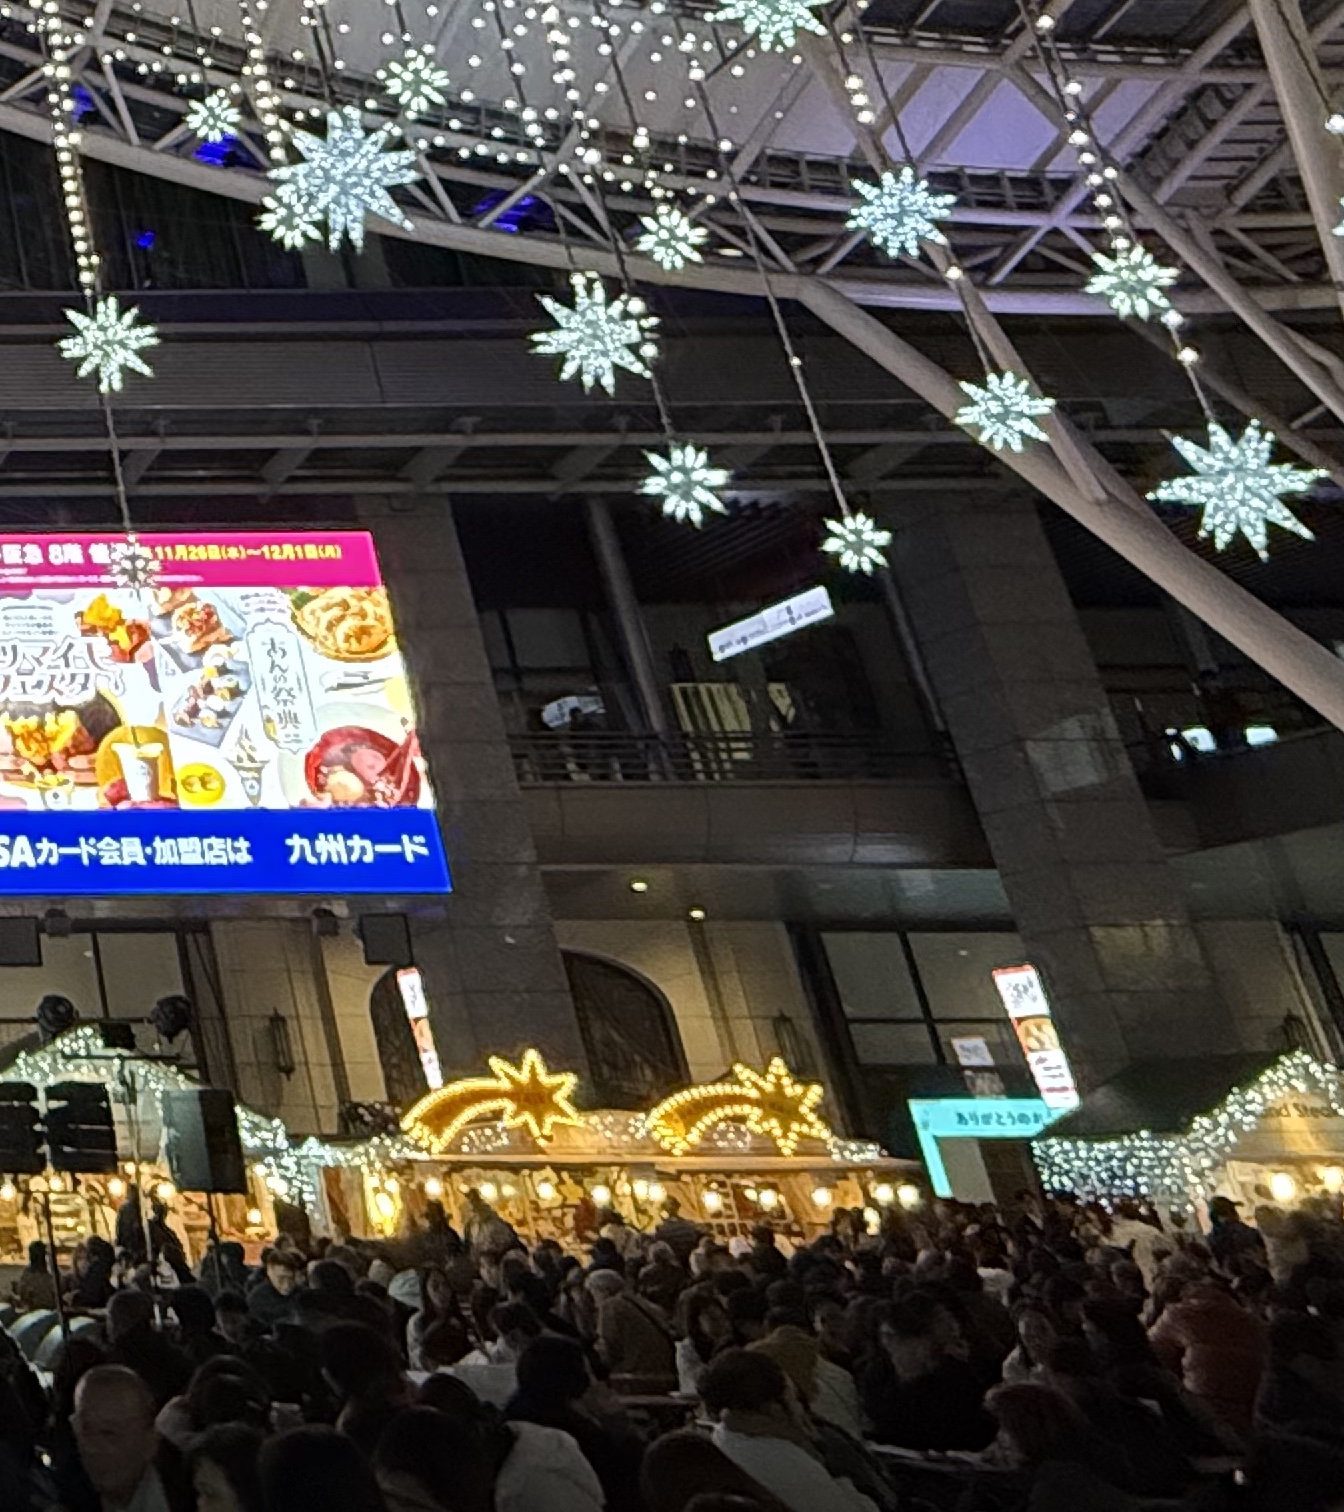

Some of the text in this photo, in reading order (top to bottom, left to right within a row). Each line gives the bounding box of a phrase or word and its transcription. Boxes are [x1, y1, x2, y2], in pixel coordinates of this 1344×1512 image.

[284, 833, 429, 865] 九州カード
